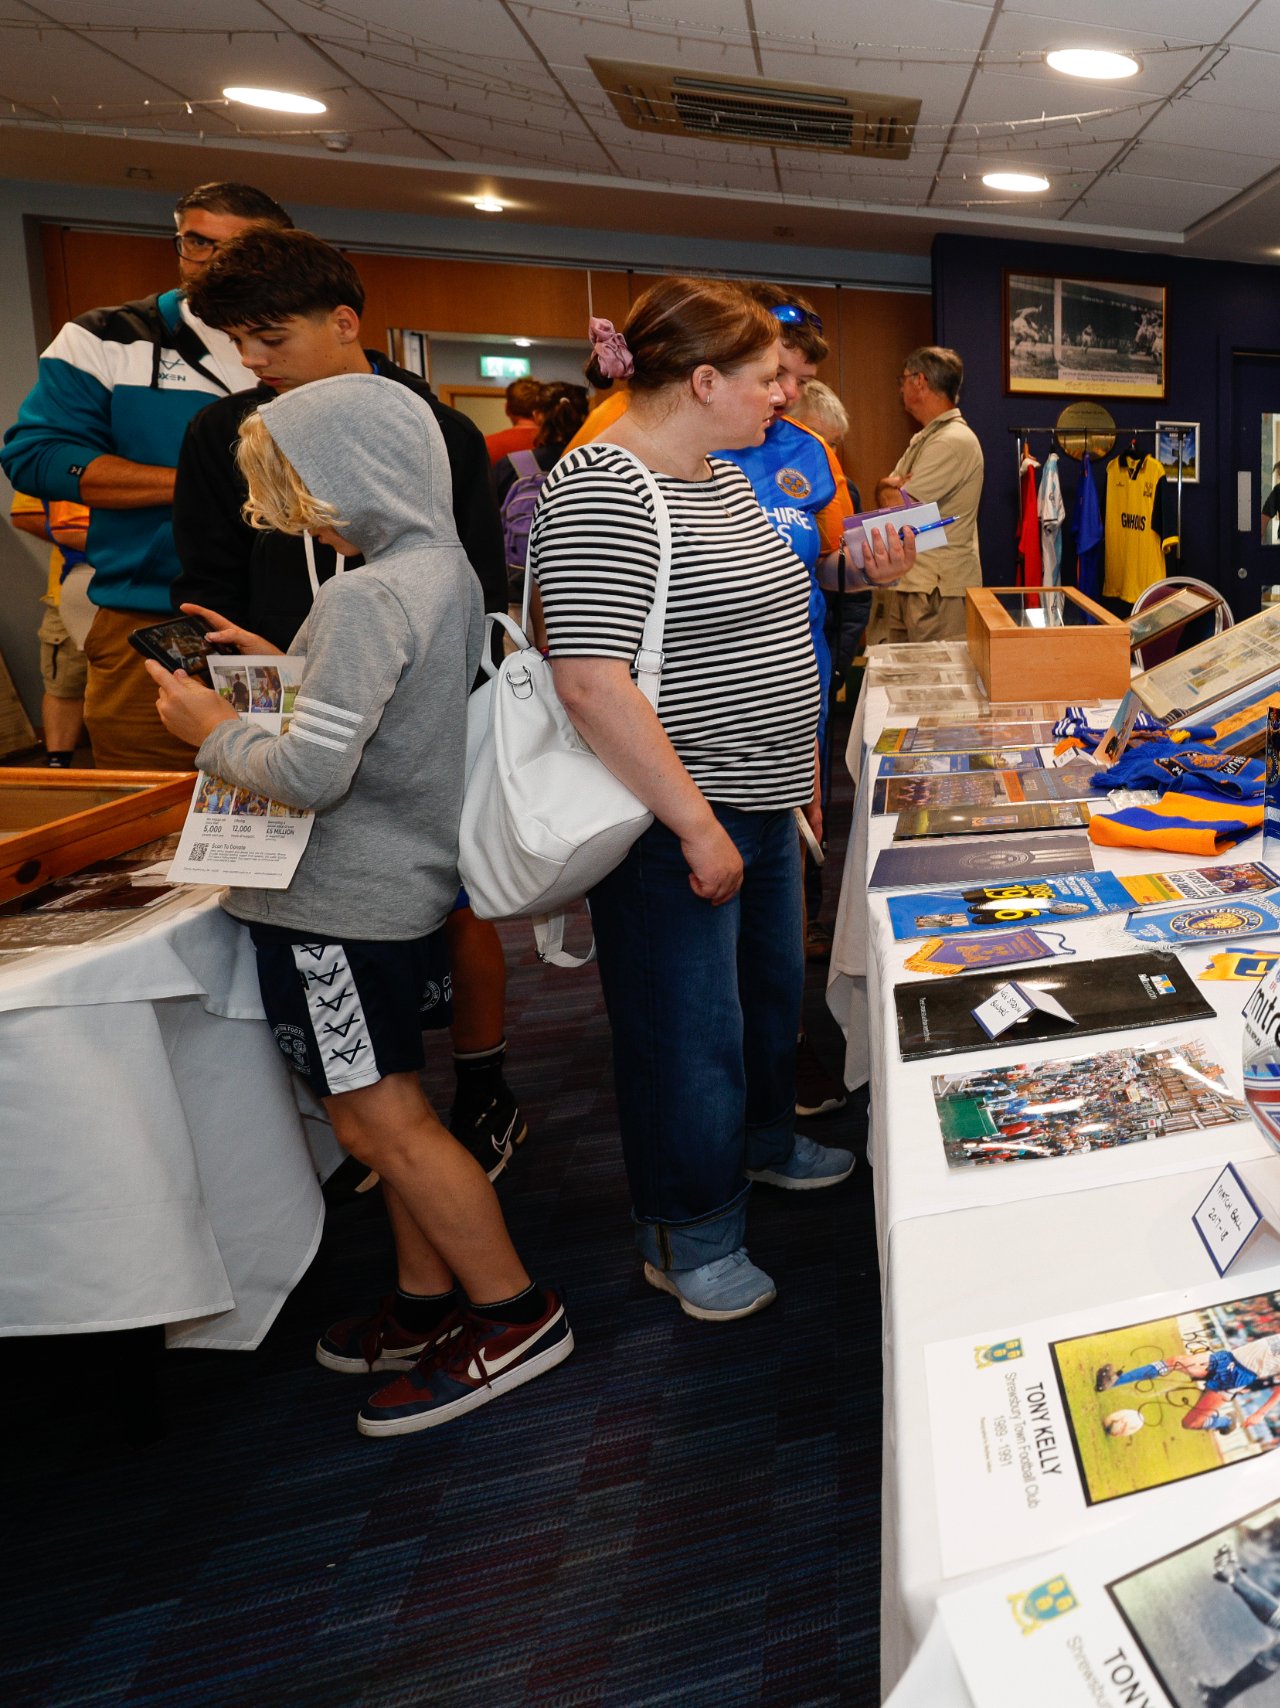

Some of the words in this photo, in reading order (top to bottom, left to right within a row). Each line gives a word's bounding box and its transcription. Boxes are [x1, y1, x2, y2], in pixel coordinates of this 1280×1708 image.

[761, 507, 812, 530] HIRE
[203, 825, 222, 833] 5,000
[232, 825, 252, 833] 12,000
[983, 884, 1041, 920] 196
[1005, 1372, 1021, 1420] Shrewsbury
[1025, 1381, 1051, 1422] TONY
[1014, 1420, 1027, 1448] Town
[1034, 1425, 1062, 1475] KELLY
[1018, 1444, 1037, 1483] Football
[1025, 1484, 1040, 1509] Club
